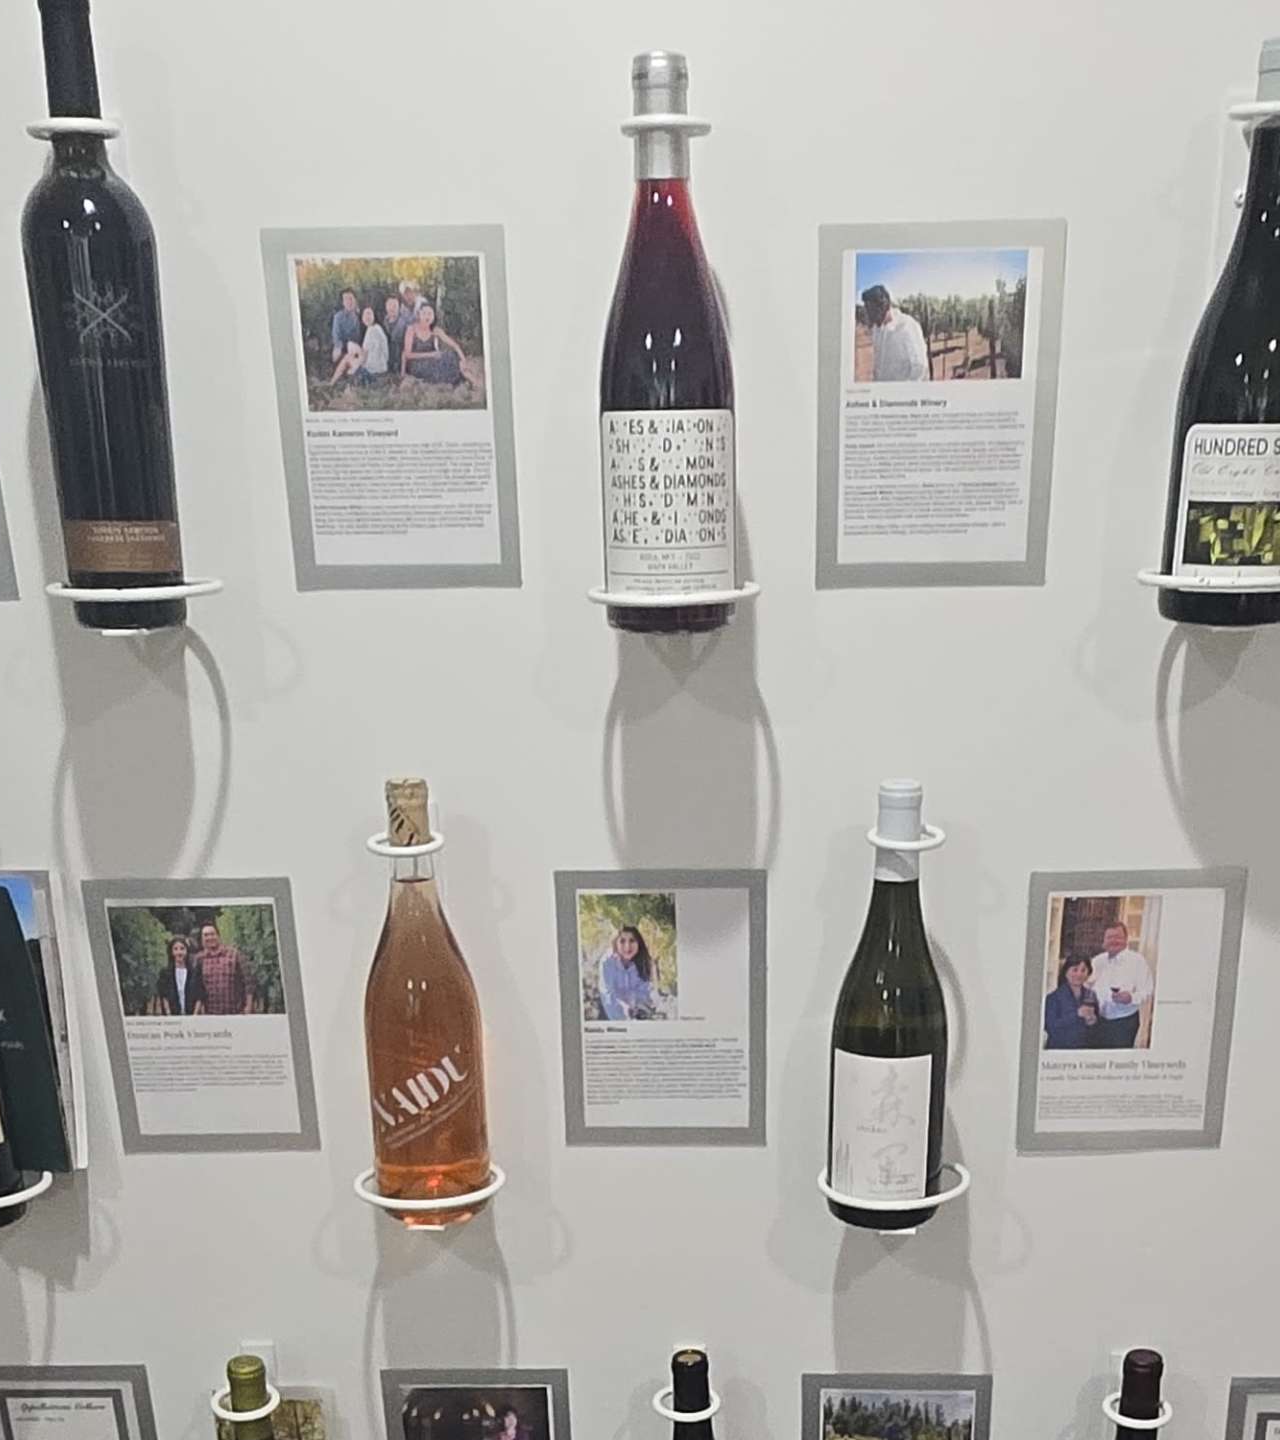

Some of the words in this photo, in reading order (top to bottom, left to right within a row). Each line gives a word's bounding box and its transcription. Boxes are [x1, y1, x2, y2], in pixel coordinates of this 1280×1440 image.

[1194, 438, 1268, 456] HUNDRED
[611, 475, 647, 490] ASHES
[649, 474, 660, 490] &
[663, 472, 727, 490] DIAMONDS
